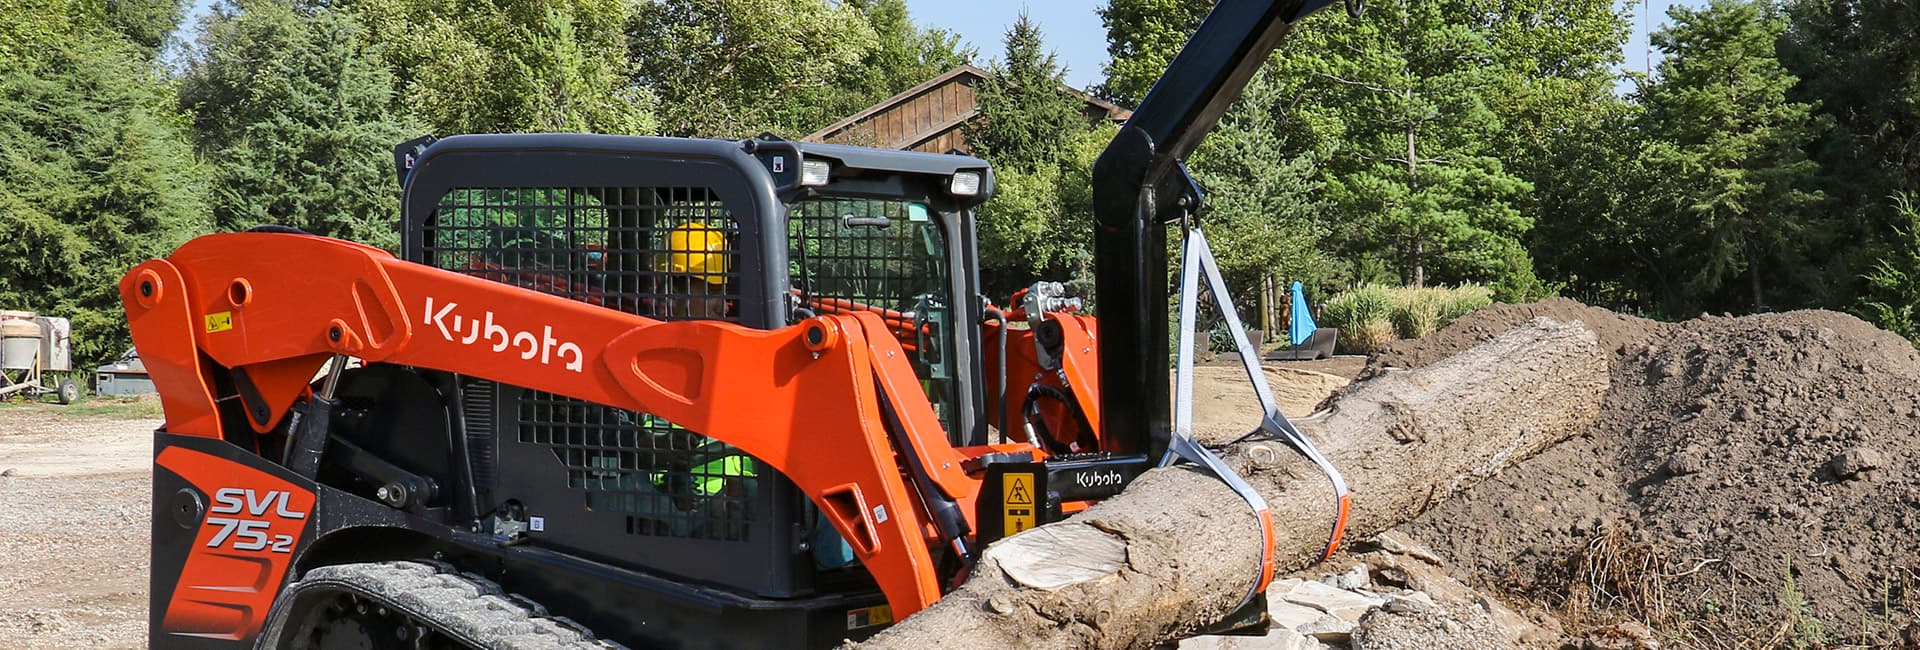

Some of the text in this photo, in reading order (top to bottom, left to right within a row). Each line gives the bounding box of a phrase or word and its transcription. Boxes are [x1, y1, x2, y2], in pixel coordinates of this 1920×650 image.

[424, 296, 583, 373] Kubota
[1076, 470, 1122, 488] Kubota
[211, 487, 305, 519] SVL
[206, 517, 293, 553] 75-2
